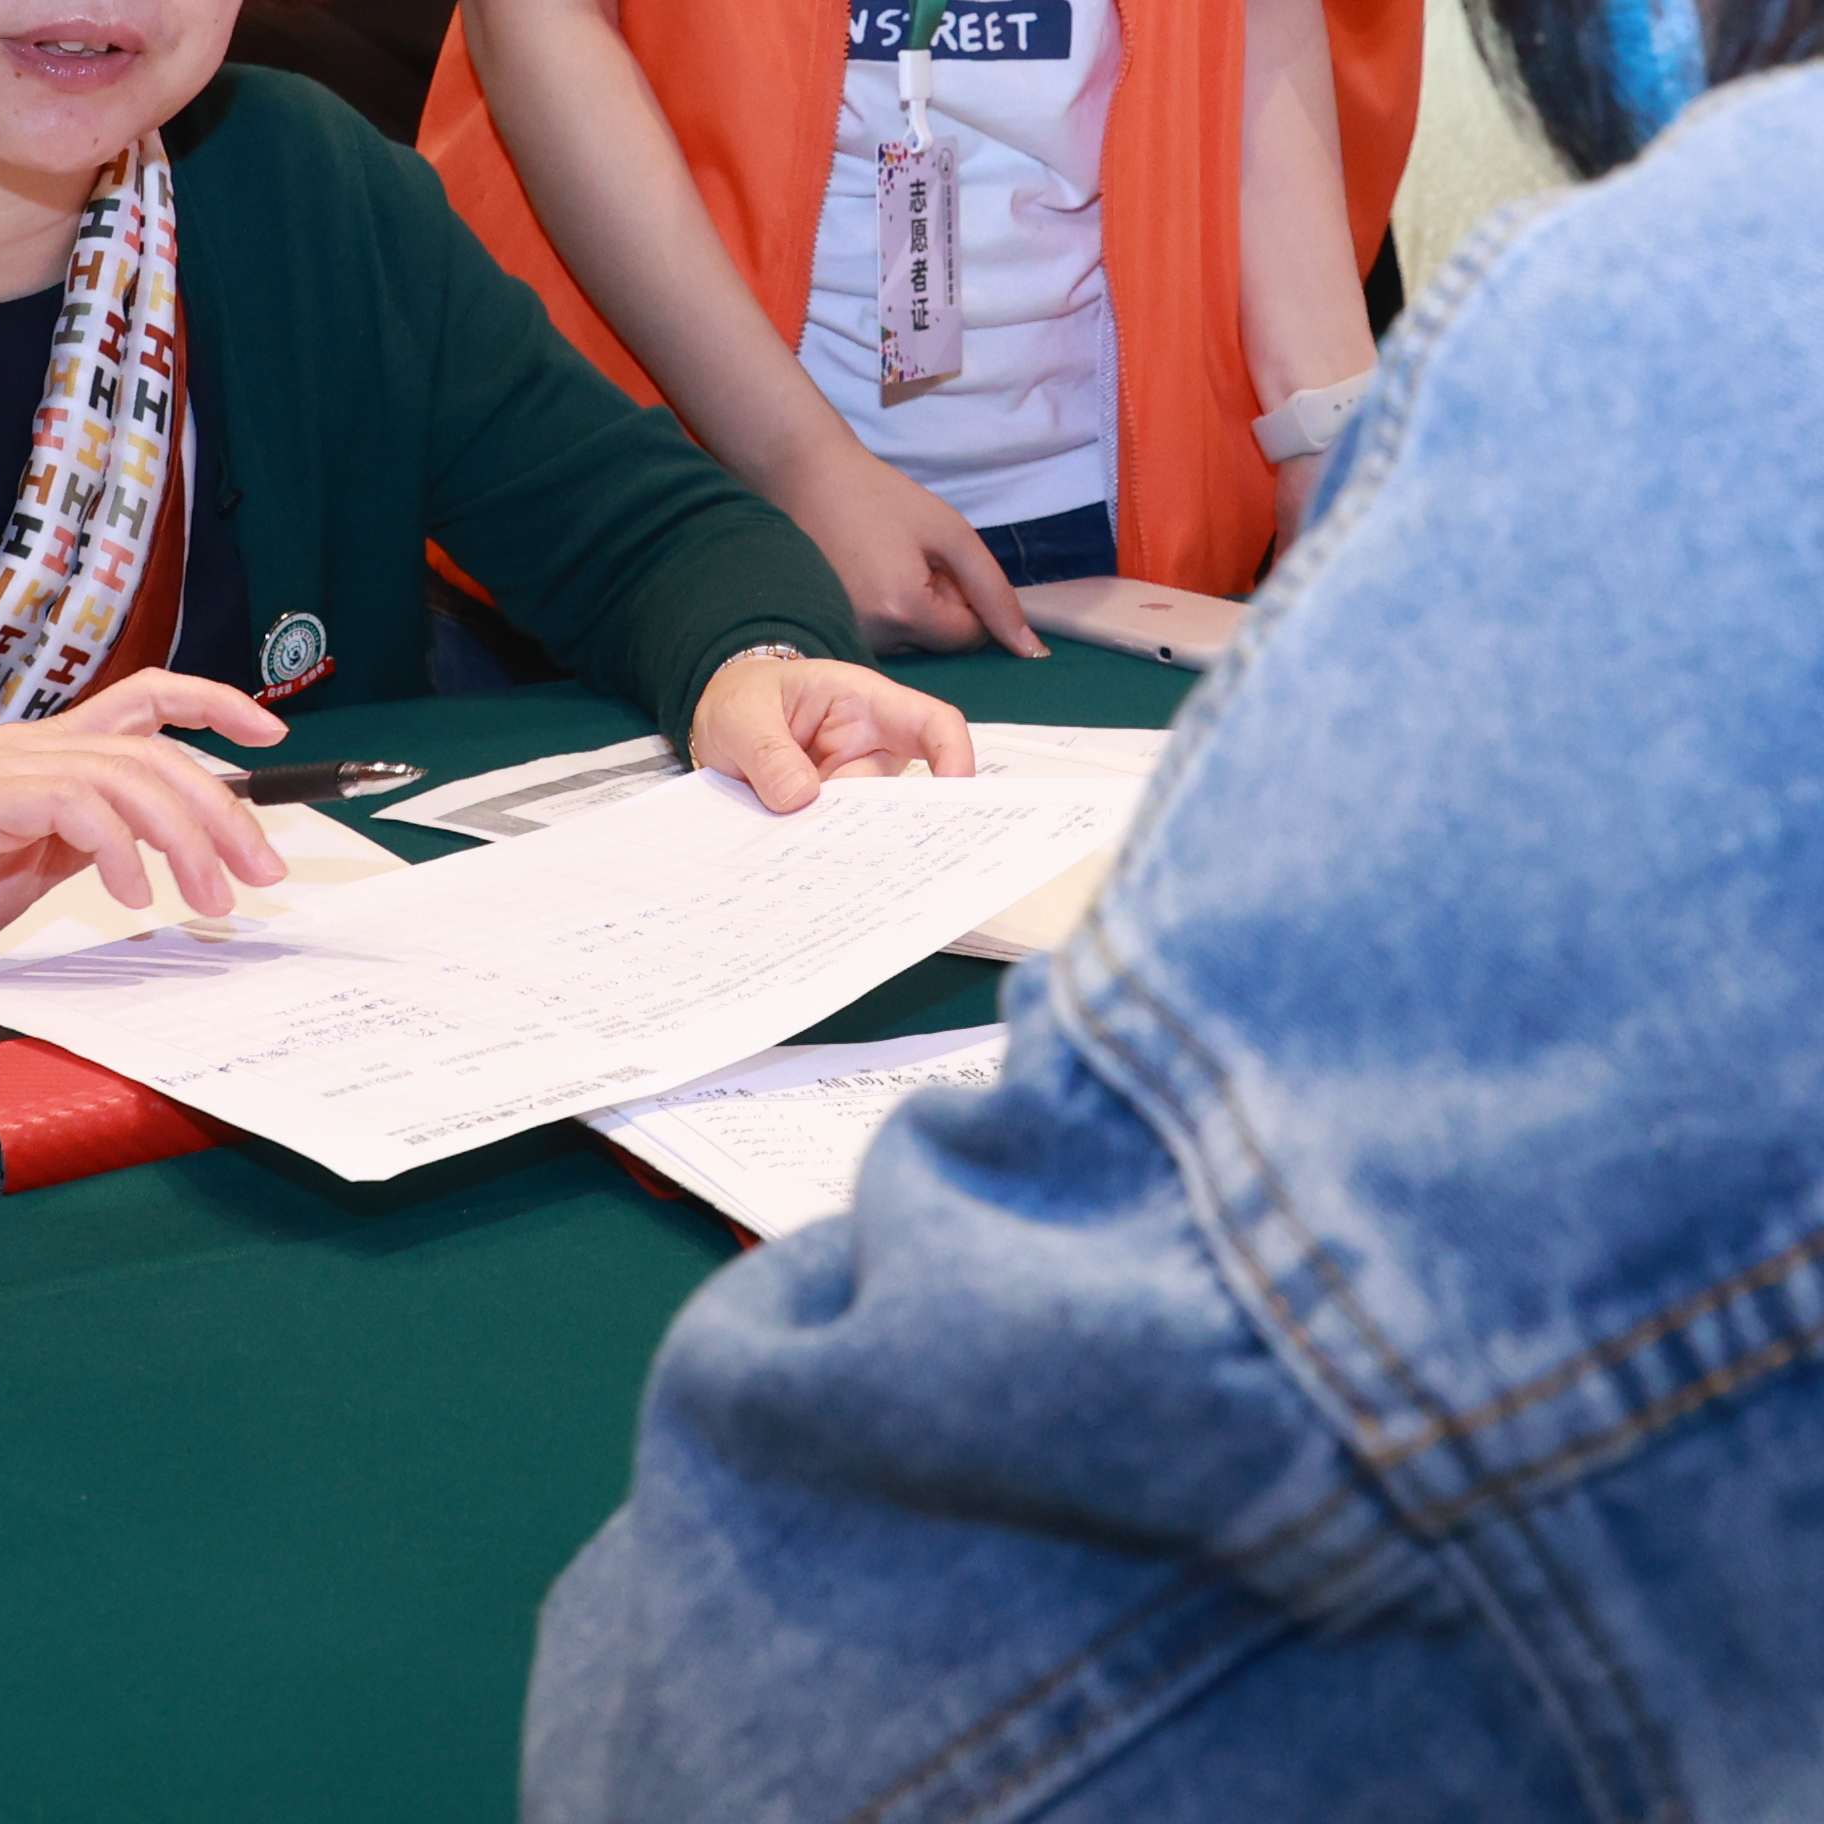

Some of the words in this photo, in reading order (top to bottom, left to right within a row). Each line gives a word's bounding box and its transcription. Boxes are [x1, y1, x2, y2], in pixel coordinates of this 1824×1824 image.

[876, 8, 1038, 53] SREET
[909, 178, 930, 332] 志愿者证
